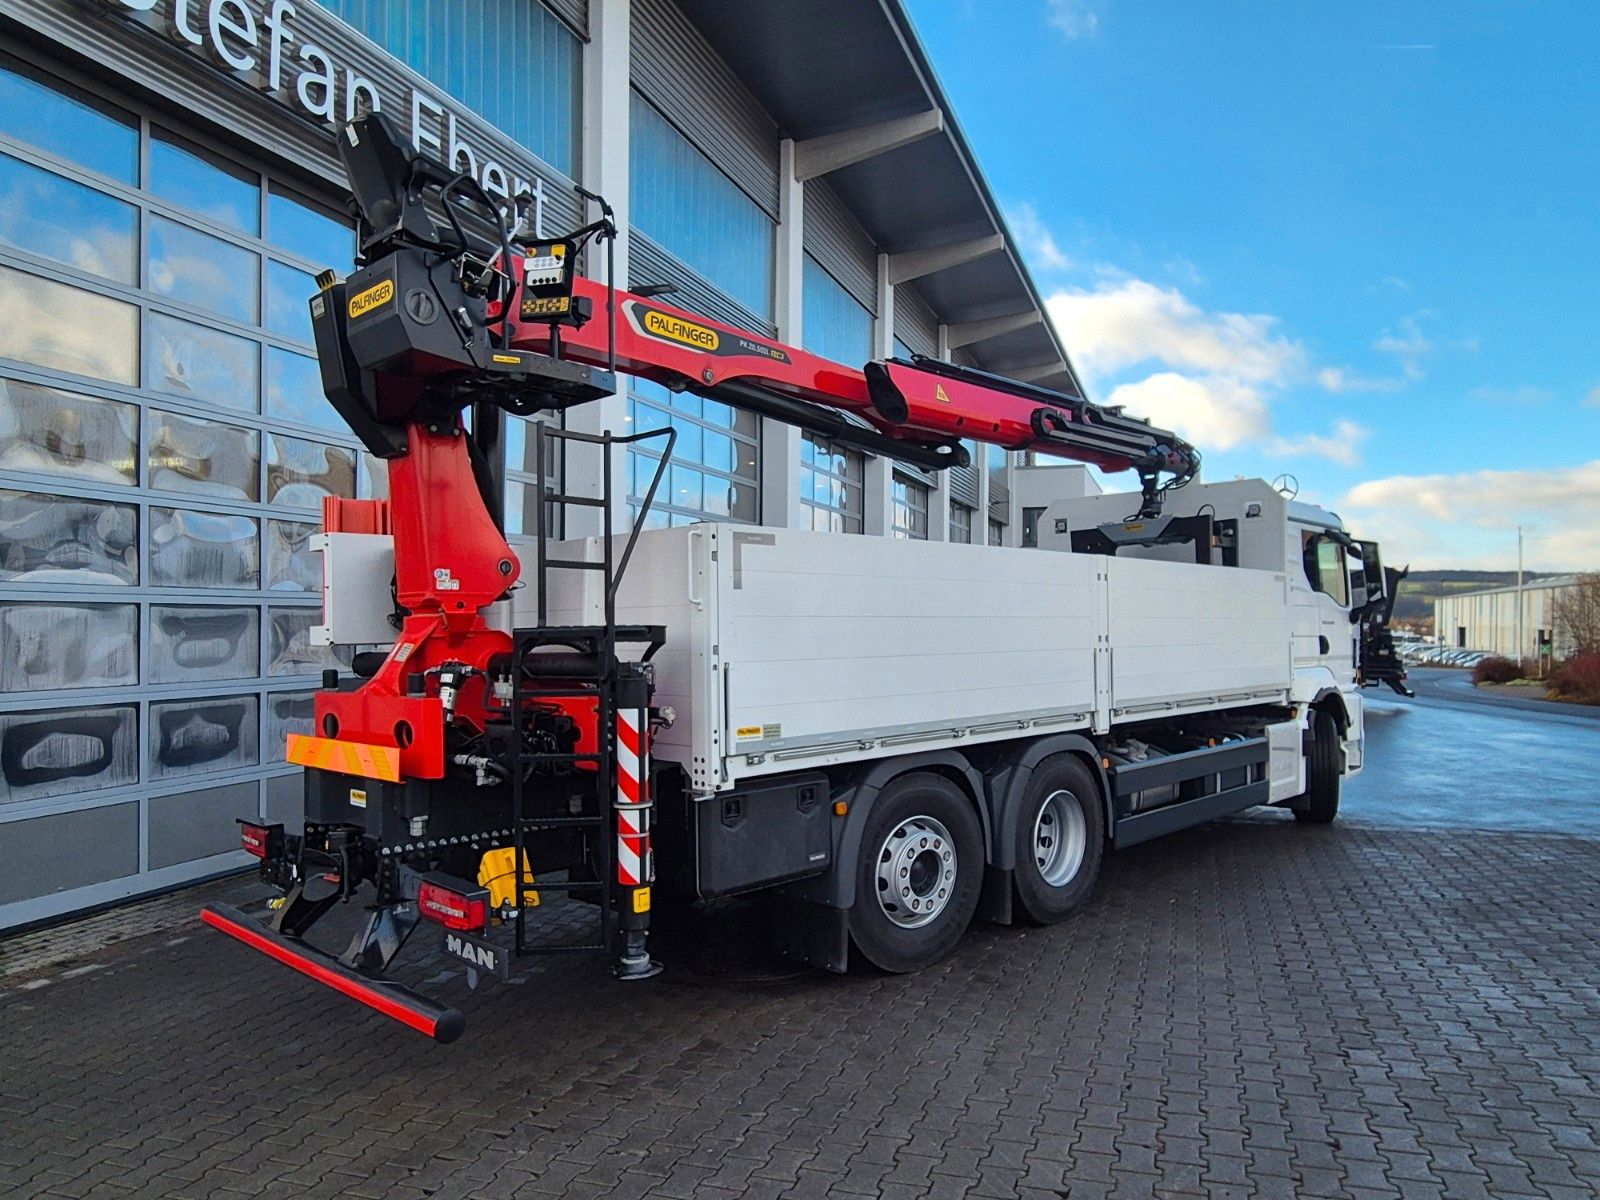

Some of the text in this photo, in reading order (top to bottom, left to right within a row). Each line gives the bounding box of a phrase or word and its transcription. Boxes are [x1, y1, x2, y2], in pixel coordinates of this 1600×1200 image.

[351, 284, 391, 314] PALFINGER
[650, 314, 715, 347] PALFINGER
[447, 933, 494, 970] MAN
